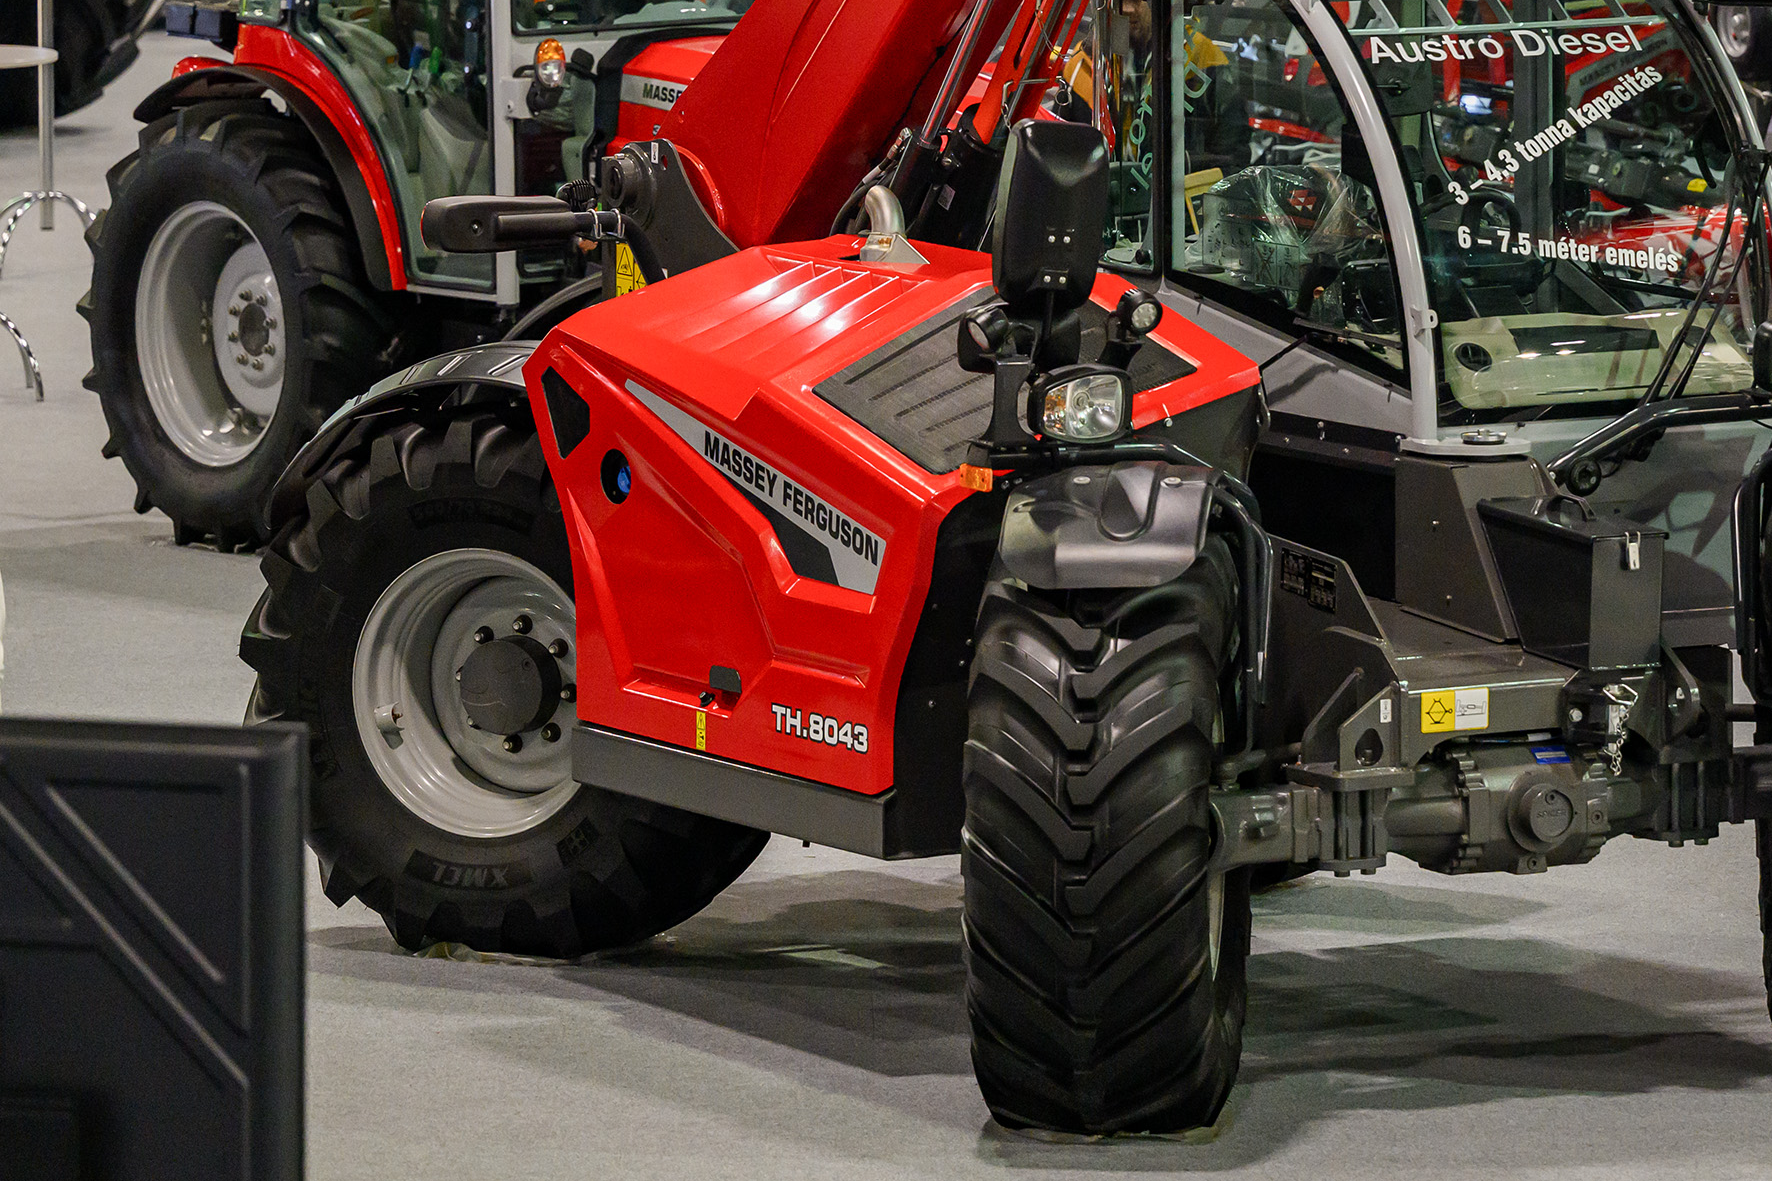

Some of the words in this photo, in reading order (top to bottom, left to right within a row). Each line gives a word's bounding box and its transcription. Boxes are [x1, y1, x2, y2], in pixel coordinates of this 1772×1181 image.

[1369, 34, 1505, 64] Austro
[1510, 25, 1643, 57] Diesel
[1447, 181, 1470, 206] 3
[1484, 149, 1520, 183] 4.3
[1514, 118, 1577, 162] tonna
[1567, 63, 1664, 129] kapacitás
[1457, 225, 1472, 249] 6
[1497, 229, 1531, 256] 7.5
[1538, 236, 1599, 263] méter
[1605, 246, 1679, 273] emelés
[704, 430, 778, 498] MASSEY
[782, 479, 879, 567] FERGUSON
[771, 701, 869, 754] TH.8043
